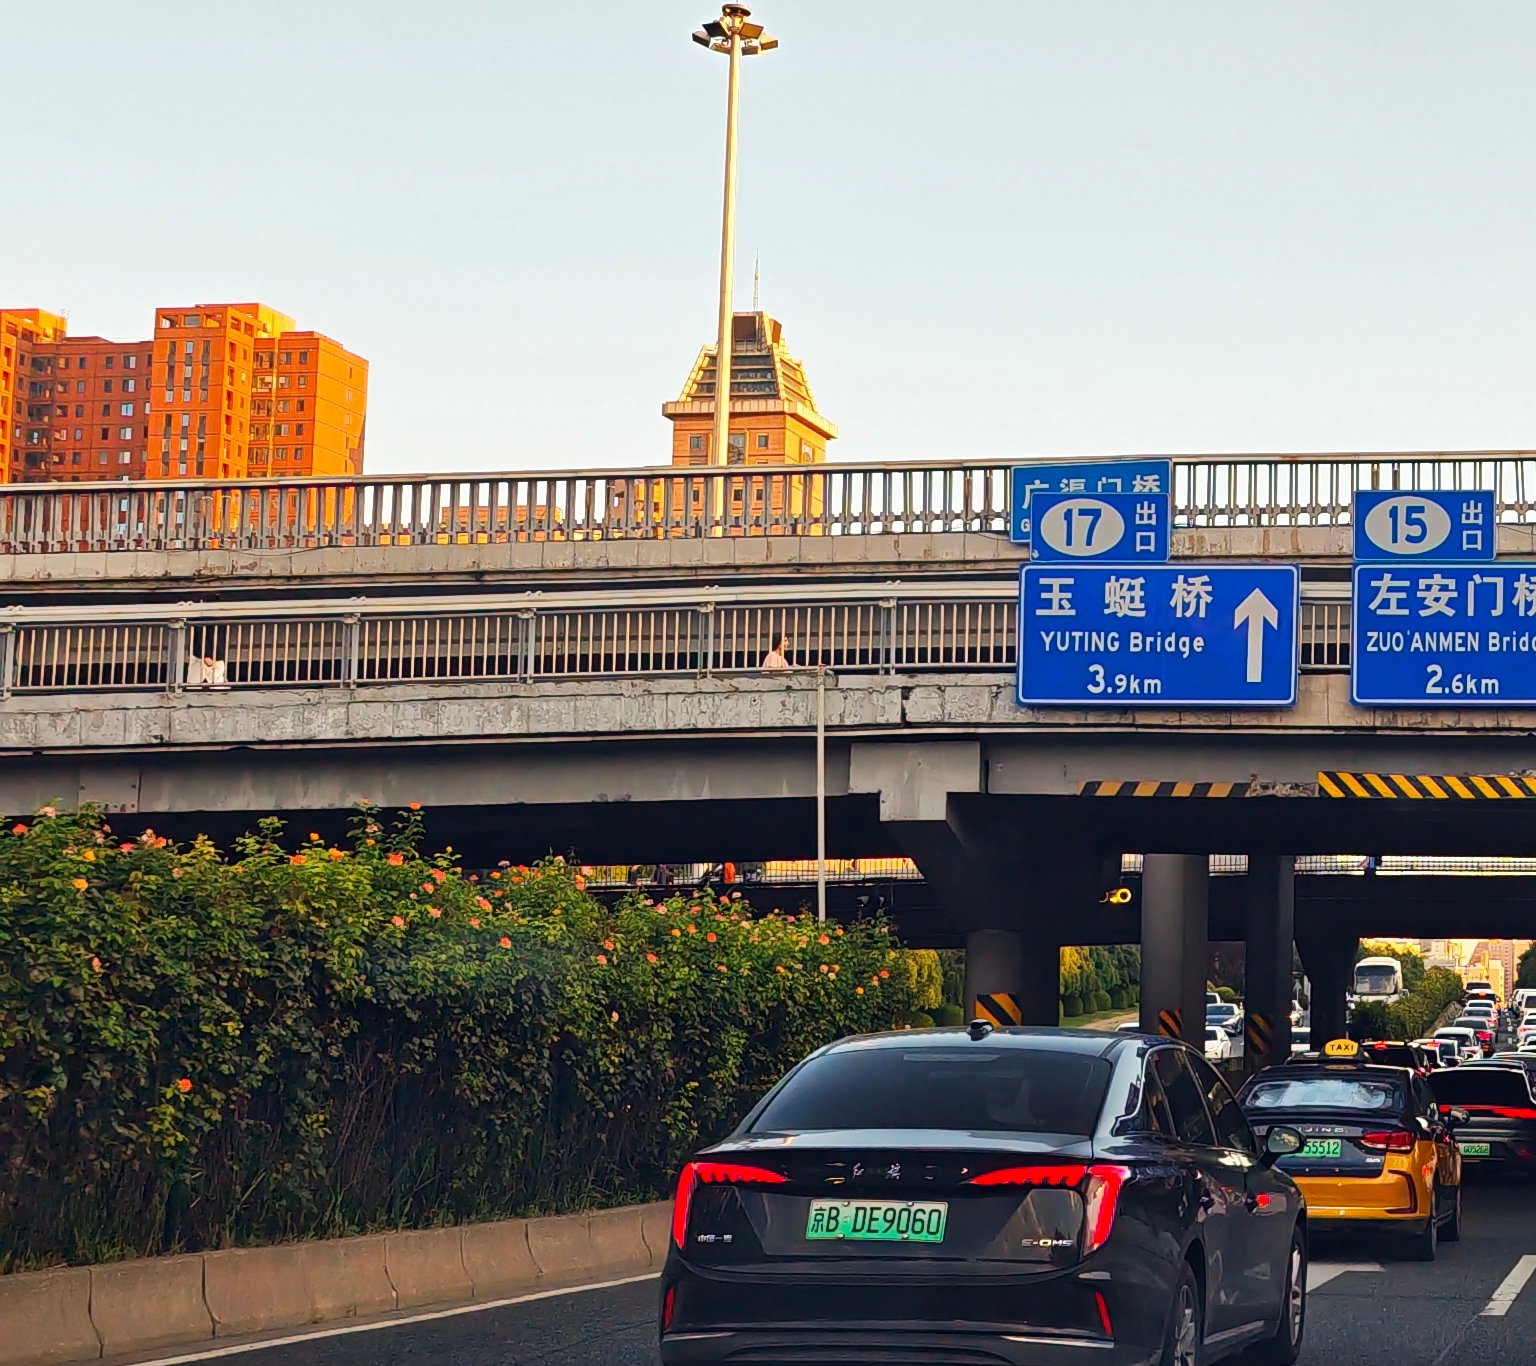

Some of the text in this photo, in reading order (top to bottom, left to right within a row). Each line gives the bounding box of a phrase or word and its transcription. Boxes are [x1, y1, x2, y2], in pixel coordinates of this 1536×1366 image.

[1063, 507, 1102, 547] 17
[1135, 500, 1157, 552] 出口
[1388, 505, 1428, 544] 15
[1461, 499, 1483, 551] 出口
[1035, 574, 1213, 618] 玉蜓桥
[1040, 631, 1205, 659] YUTING Bridge
[1366, 630, 1480, 652] ZUO'ANMEN
[1086, 663, 1162, 694] 3.9km
[1425, 663, 1499, 694] 2.6km
